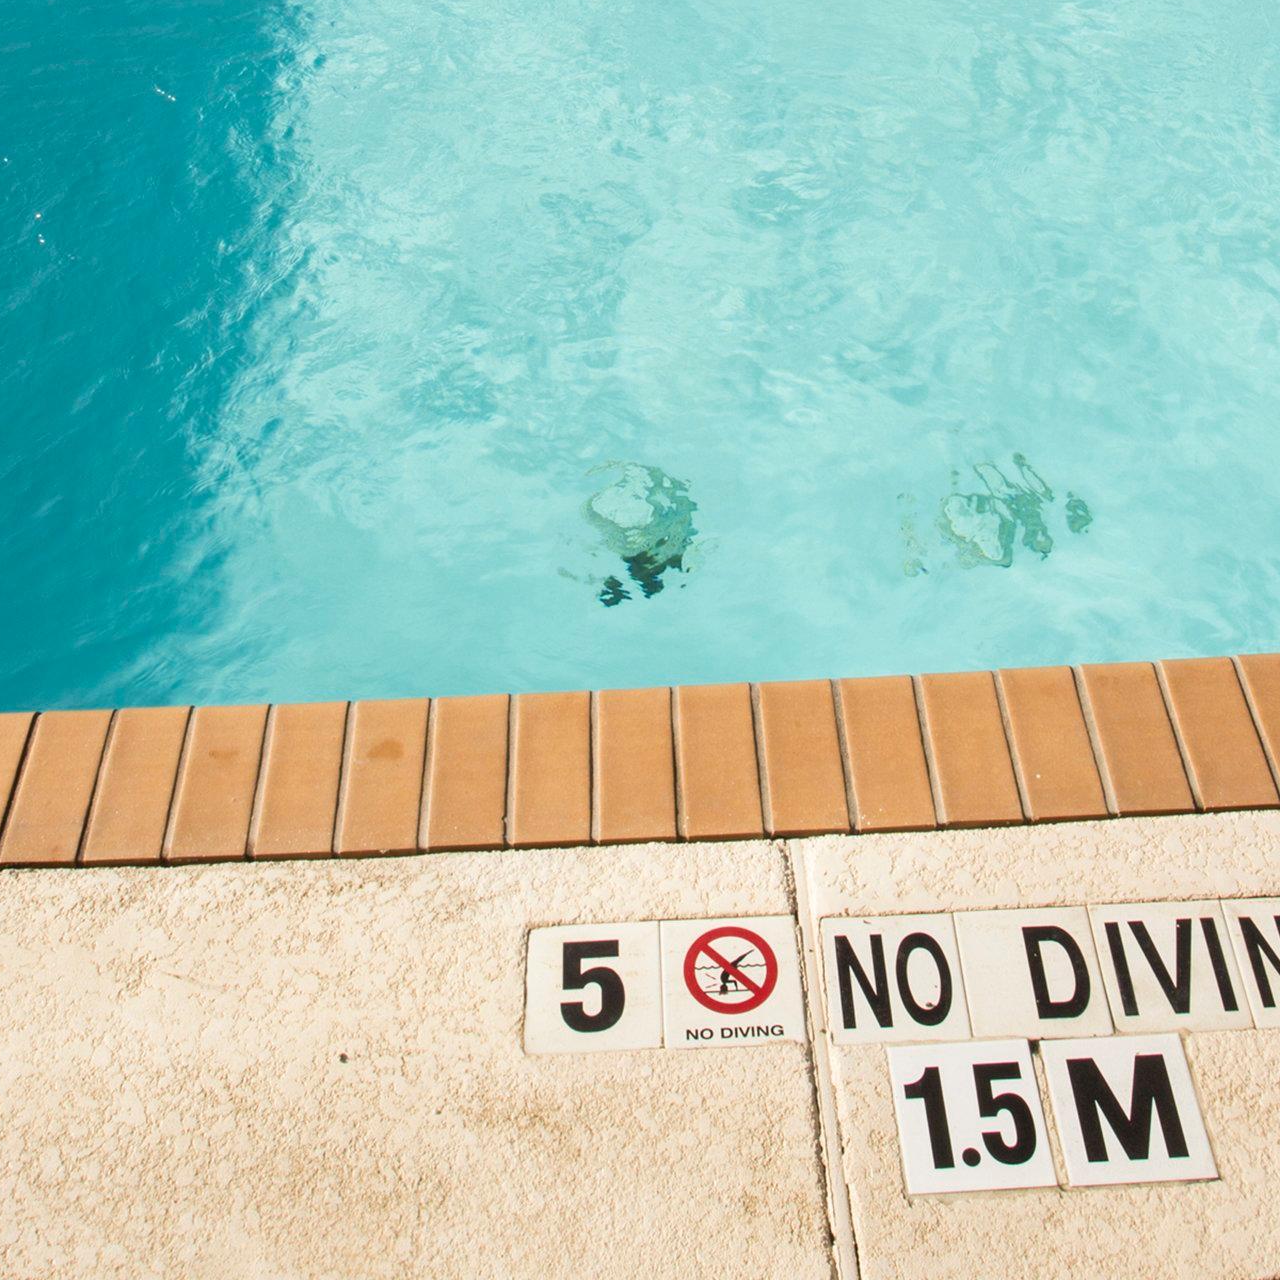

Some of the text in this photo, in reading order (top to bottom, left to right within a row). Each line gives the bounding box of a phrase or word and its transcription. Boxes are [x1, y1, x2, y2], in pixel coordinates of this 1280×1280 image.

[560, 940, 625, 1033] 5
[834, 932, 953, 1029] NO
[686, 1024, 784, 1041] NO DIVING
[903, 1054, 1190, 1169] 1.5 M
